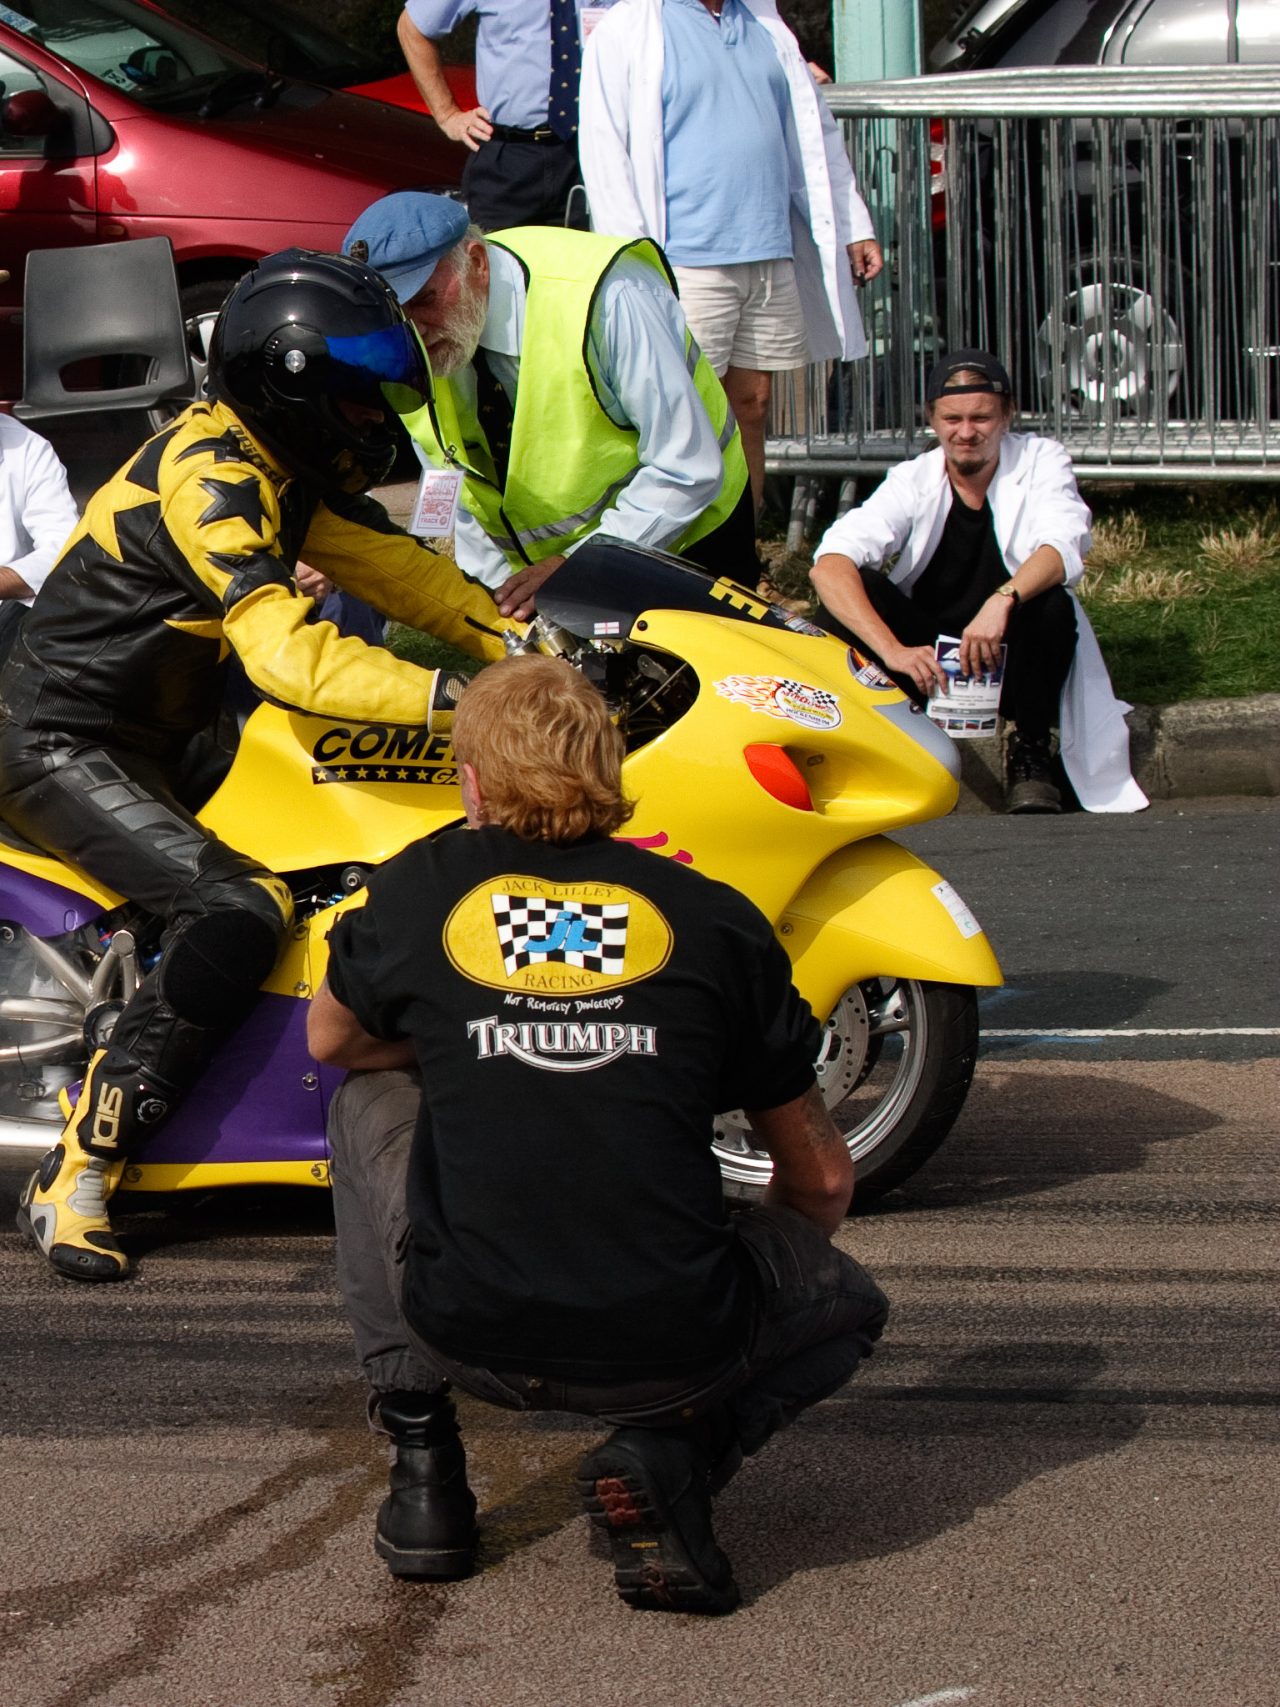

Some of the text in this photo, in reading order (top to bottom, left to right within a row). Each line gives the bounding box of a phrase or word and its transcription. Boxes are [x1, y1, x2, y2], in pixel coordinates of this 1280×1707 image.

[313, 726, 457, 762] COME
[502, 880, 618, 899] JACK LILLEY
[524, 973, 594, 990] RACING
[466, 1014, 659, 1073] TRIUMPH
